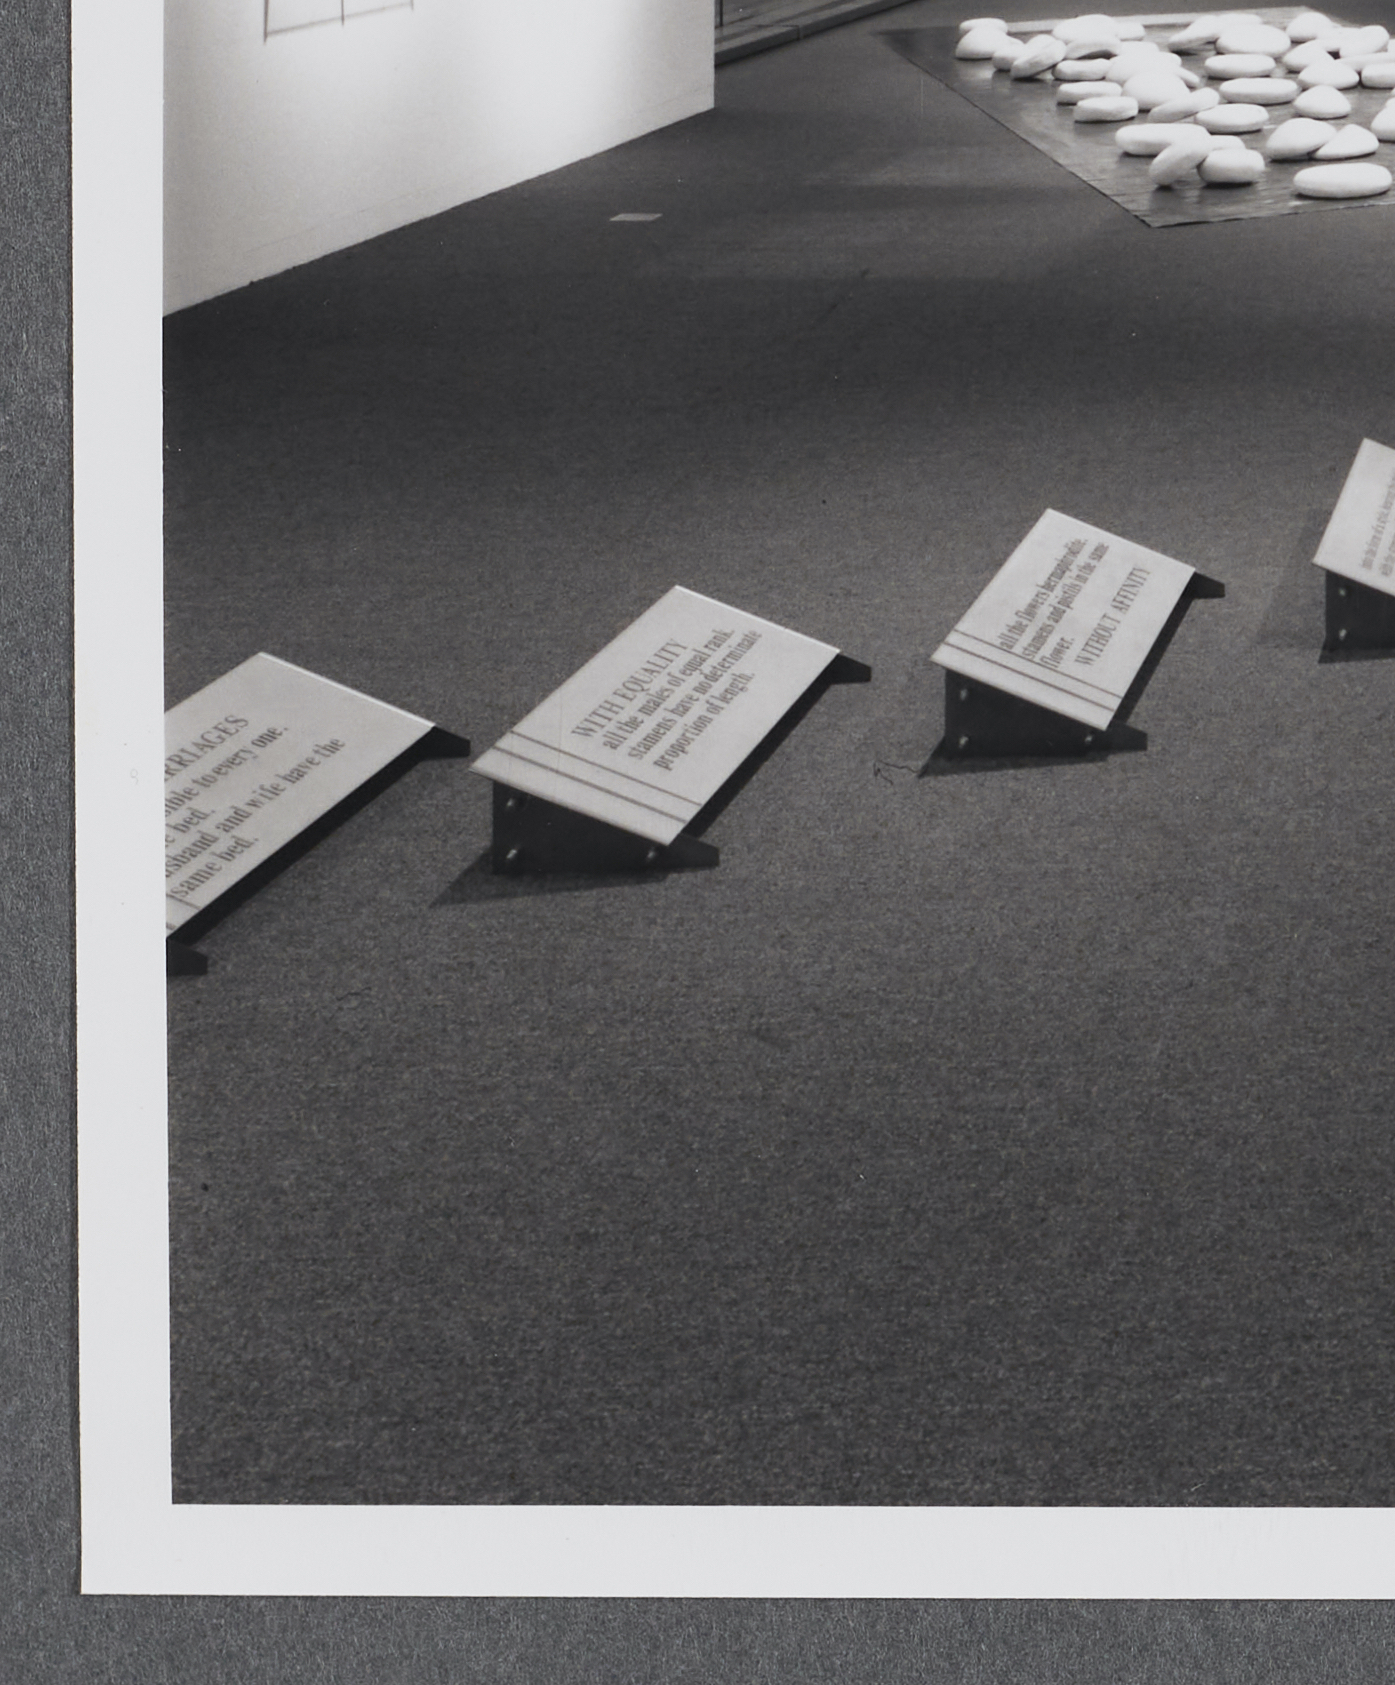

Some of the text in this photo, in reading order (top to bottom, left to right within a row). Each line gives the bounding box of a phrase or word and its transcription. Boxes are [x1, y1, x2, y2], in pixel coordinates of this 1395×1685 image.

[1076, 561, 1097, 576] the
[1088, 542, 1109, 562] same
[1069, 572, 1089, 585] in
[1005, 619, 1029, 636] the
[1046, 603, 1067, 624] and
[1073, 566, 1150, 666] WITHOUT AFFINITY
[996, 631, 1019, 650] all
[1021, 621, 1055, 659] stamens
[1038, 636, 1075, 669] flower.
[570, 637, 688, 737] WITH EQUALITY
[601, 628, 735, 750] all the males of equal rank.
[626, 629, 763, 760] stamens have no determinate
[652, 672, 755, 772] proportion of length.
[164, 715, 249, 782] RRIAGES
[165, 726, 289, 817] ible to every one.
[215, 805, 253, 833] and
[245, 784, 287, 809] wife
[274, 754, 321, 785] have
[312, 737, 346, 759] the
[166, 806, 216, 833] bed.
[170, 835, 260, 899] same bed.
